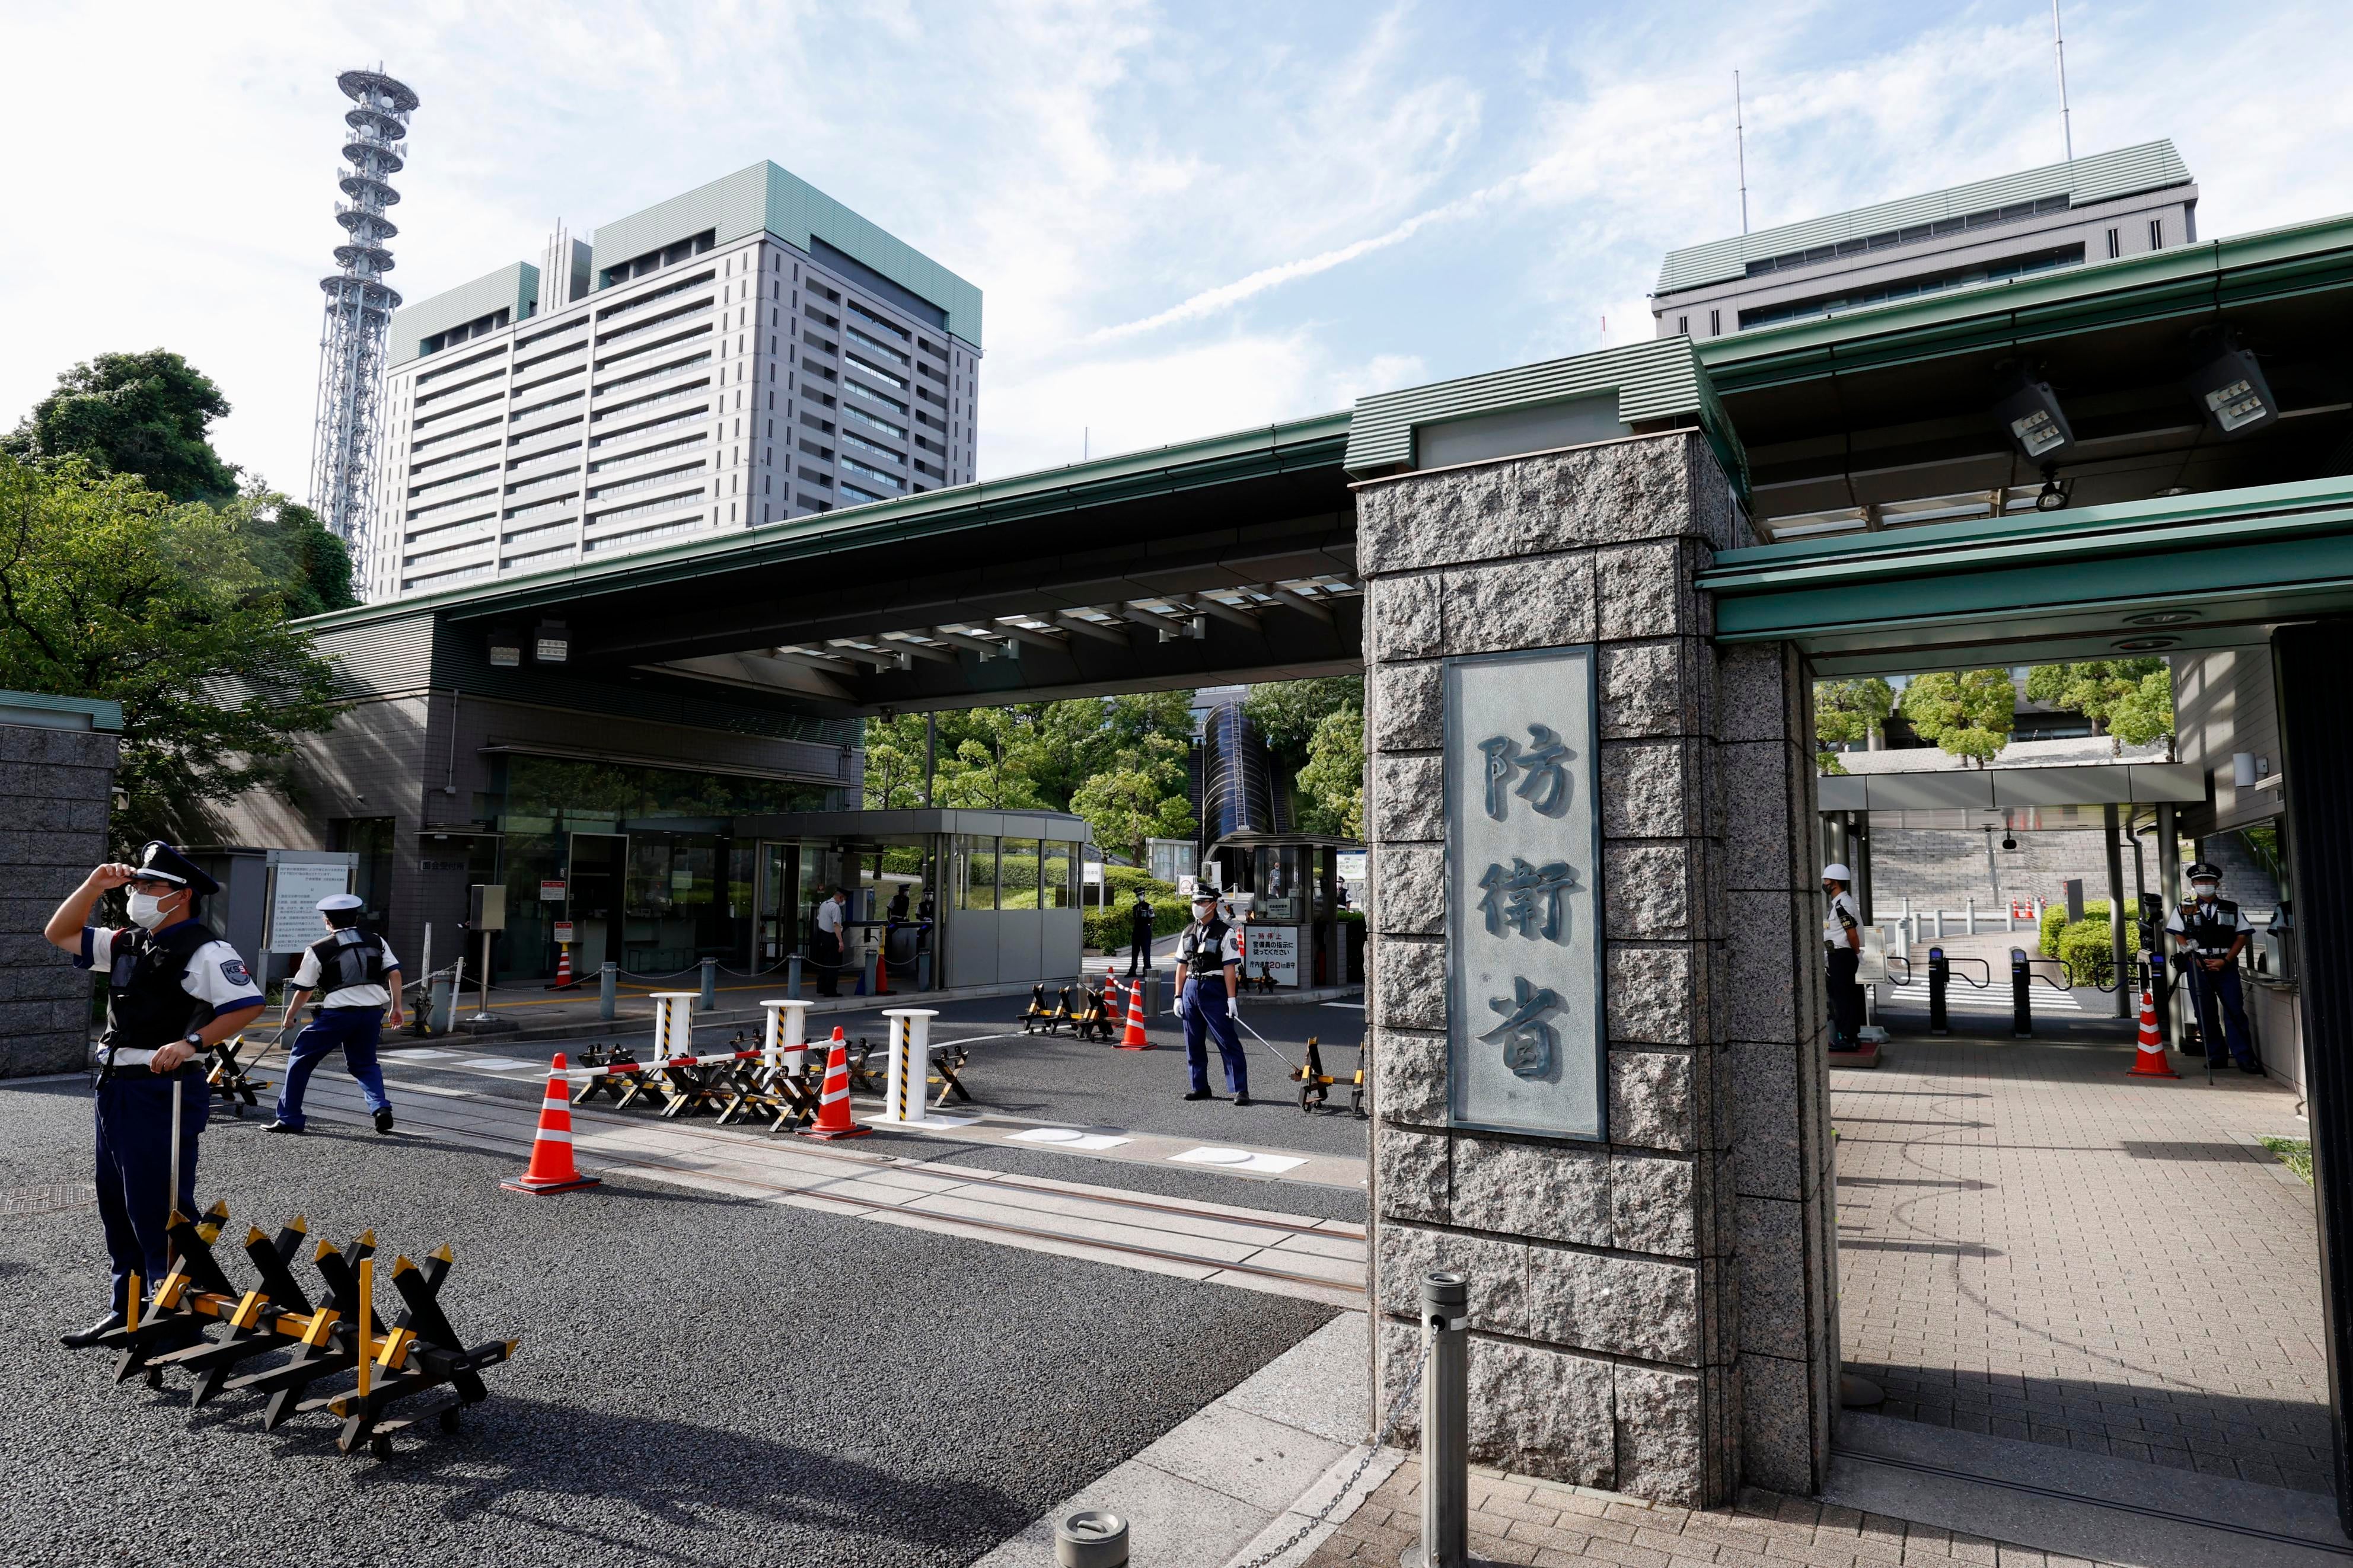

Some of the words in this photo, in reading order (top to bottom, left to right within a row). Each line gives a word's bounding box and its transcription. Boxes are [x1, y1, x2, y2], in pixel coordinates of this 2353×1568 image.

[422, 861, 466, 871] 面会受付所
[1475, 722, 1574, 1079] 防衛省
[227, 966, 245, 974] KSS
